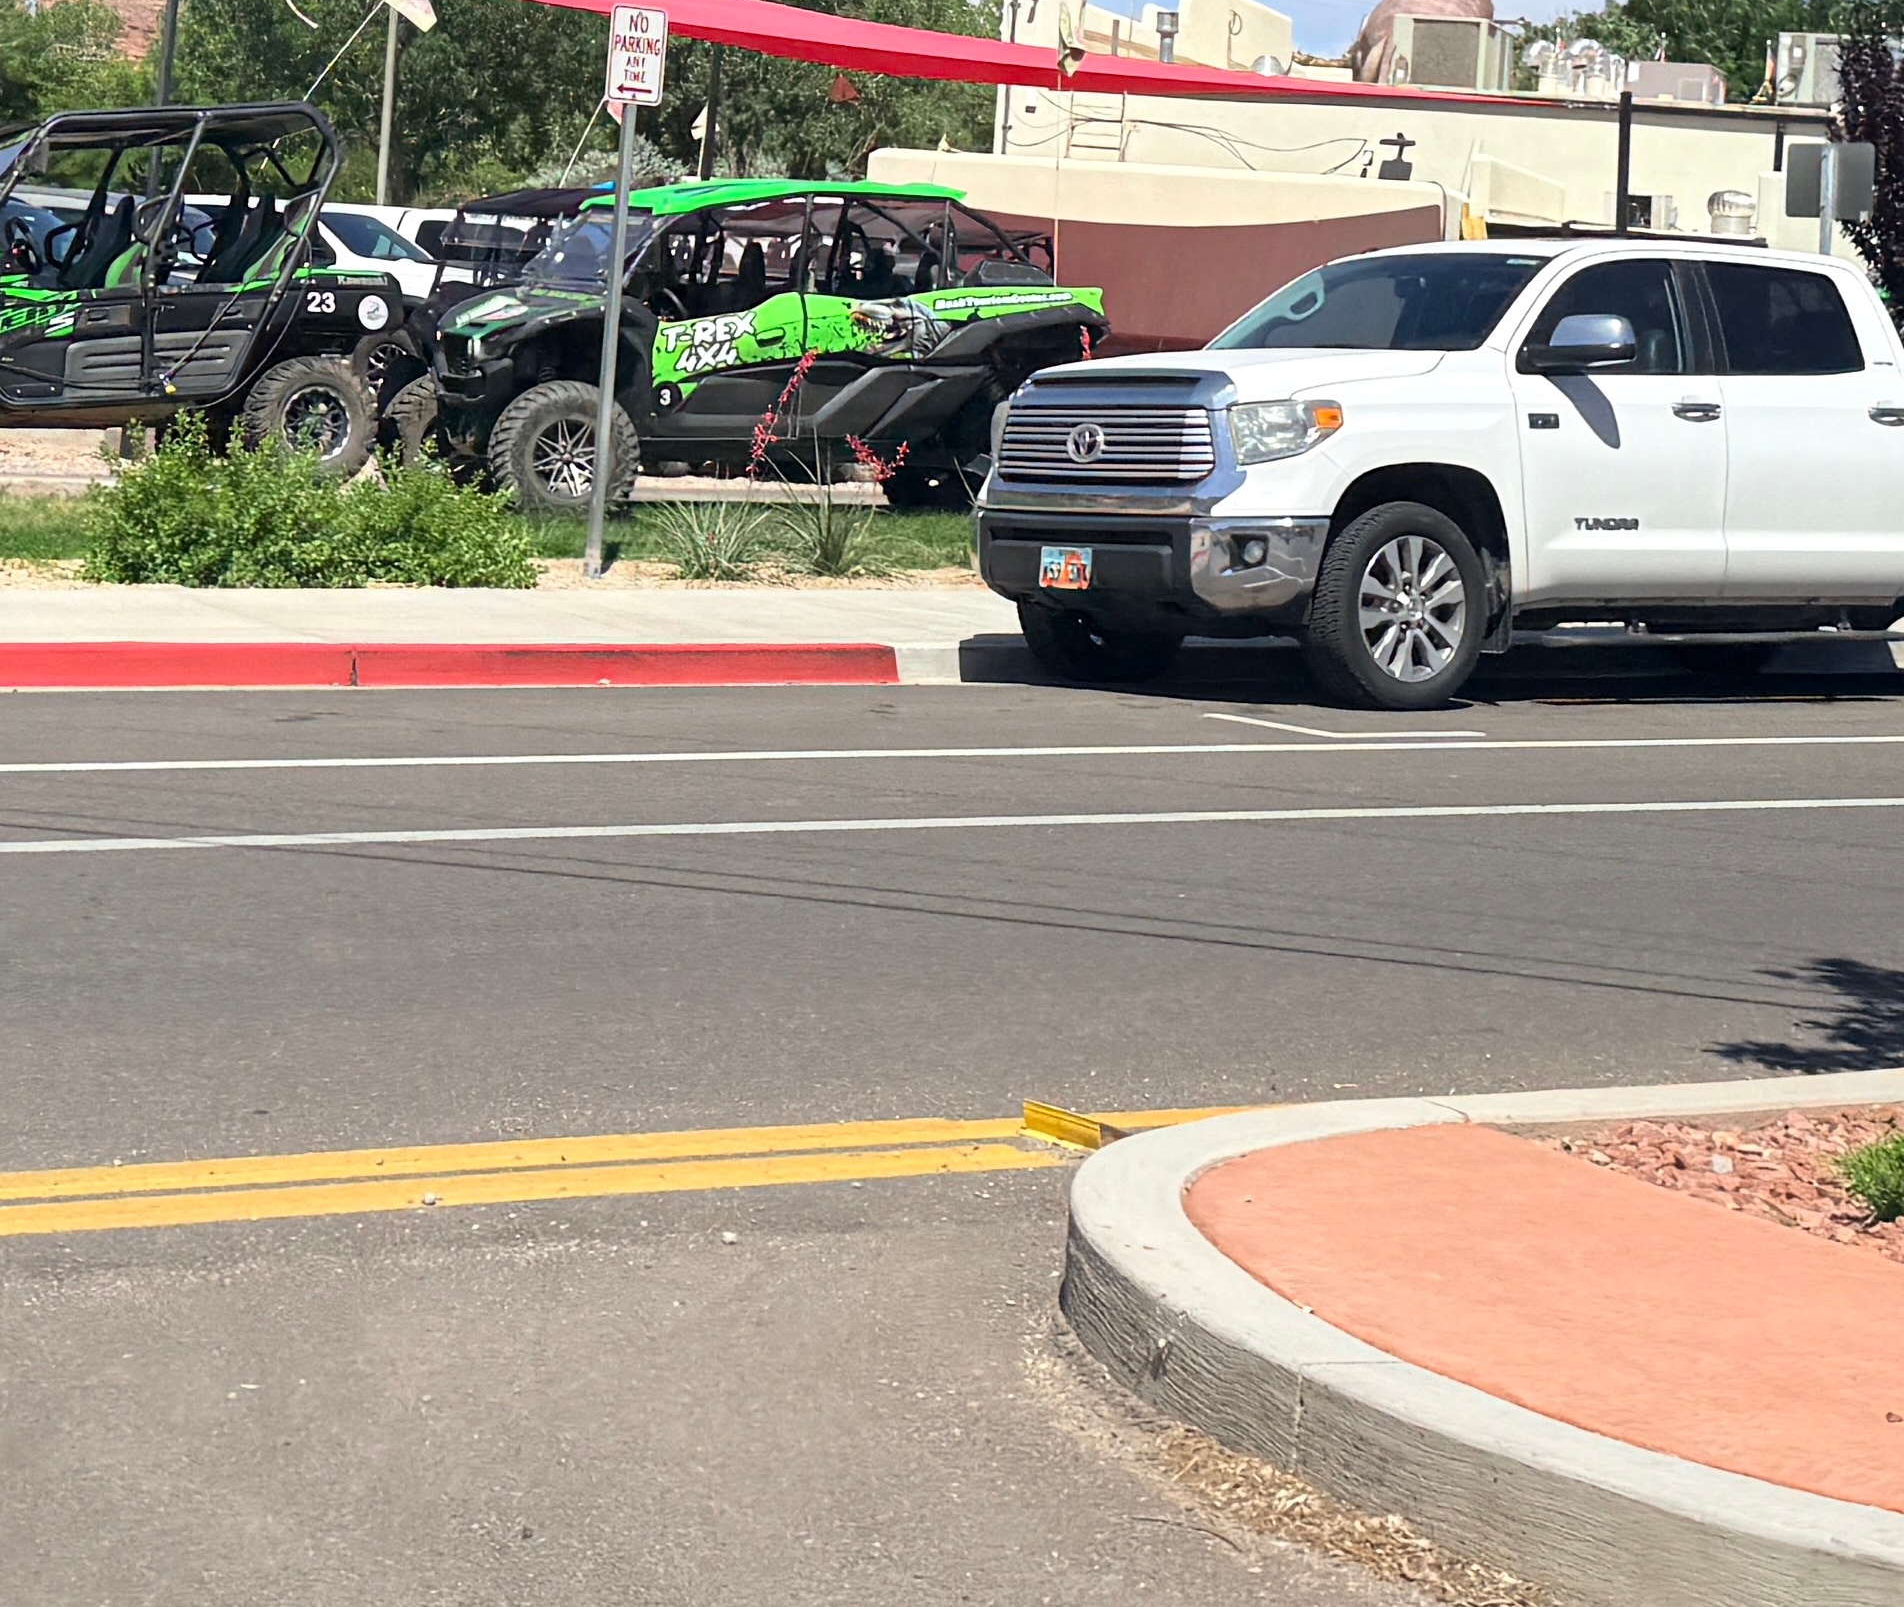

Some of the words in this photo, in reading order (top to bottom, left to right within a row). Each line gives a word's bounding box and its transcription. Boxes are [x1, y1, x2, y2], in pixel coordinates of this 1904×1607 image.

[629, 13, 650, 34] NO
[613, 34, 662, 57] PARKING
[625, 55, 647, 69] ANY
[623, 68, 647, 84] TIME
[306, 290, 337, 314] 23
[660, 310, 758, 354] T-REX
[658, 387, 672, 407] 3
[1573, 517, 1640, 532] TUNDRA
